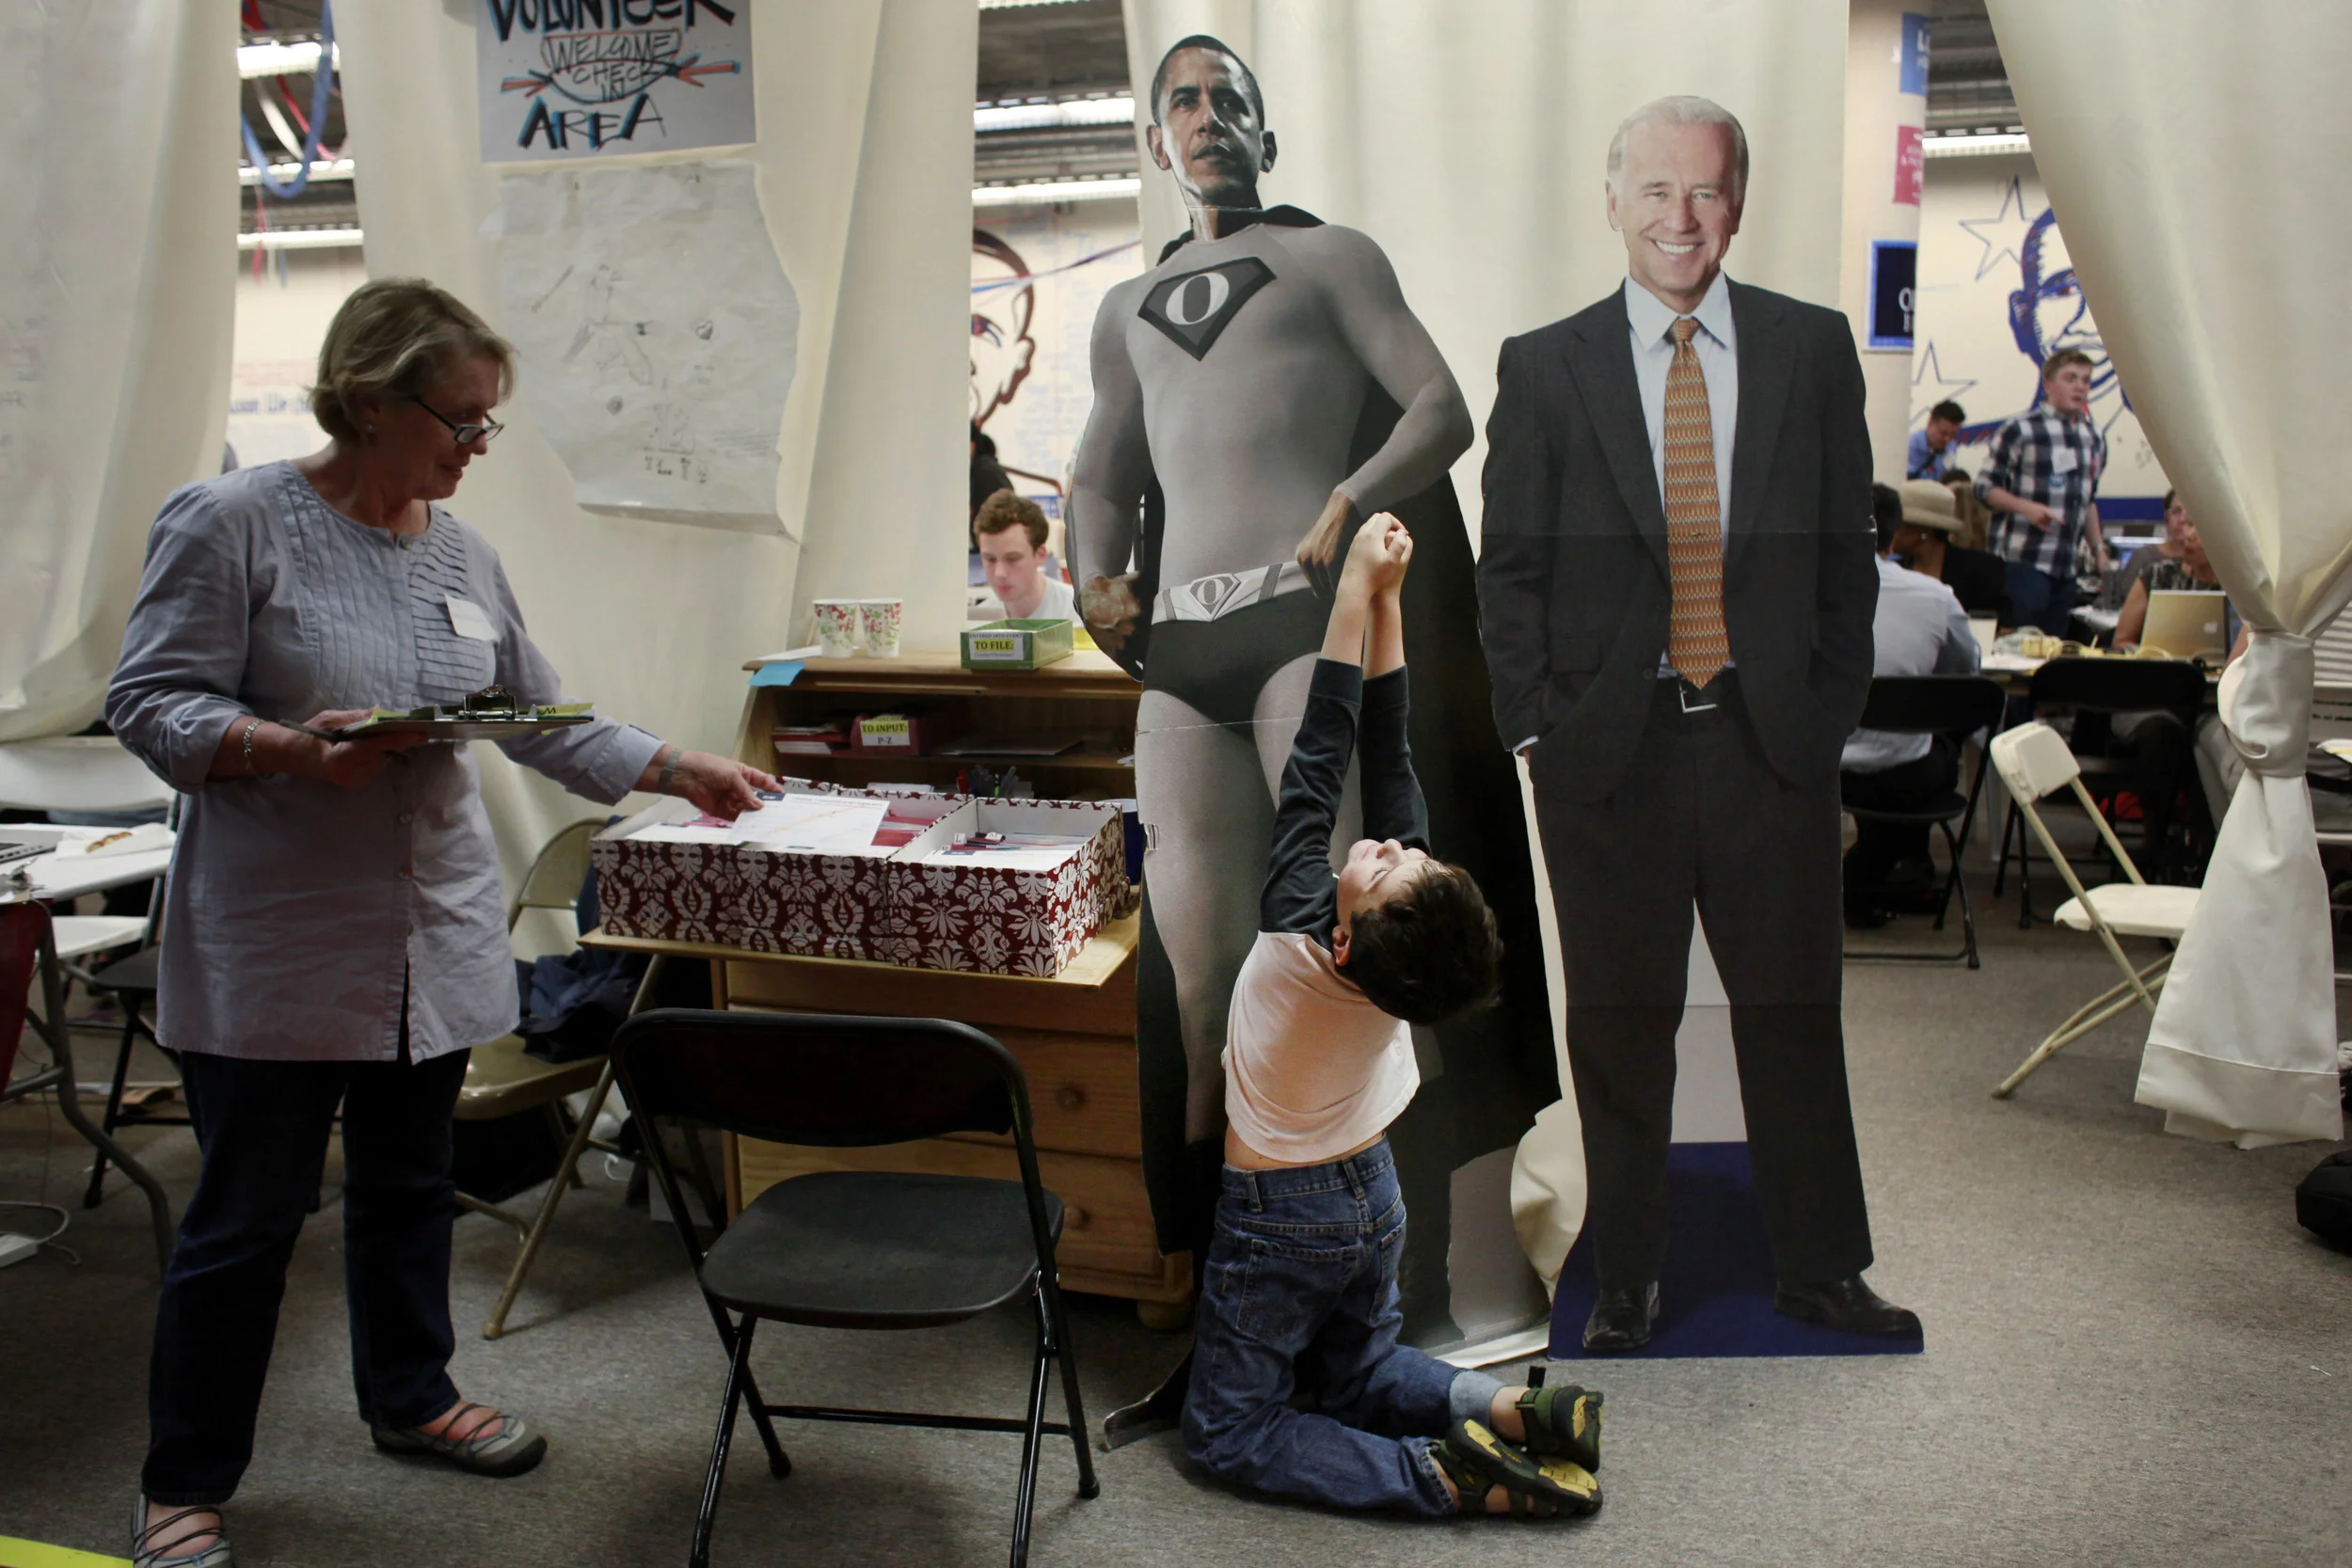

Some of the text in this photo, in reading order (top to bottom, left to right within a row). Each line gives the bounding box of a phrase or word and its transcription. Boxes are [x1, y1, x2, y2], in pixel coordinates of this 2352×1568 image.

[547, 34, 676, 73] WELCOME
[572, 62, 661, 85] CHECK
[600, 78, 626, 102] IN
[517, 92, 666, 150] AREA
[1166, 272, 1229, 325] O
[1197, 578, 1225, 605] O
[975, 641, 1014, 650] TO FILE:
[861, 723, 908, 733] TO INPUT:
[955, 833, 961, 843] L
